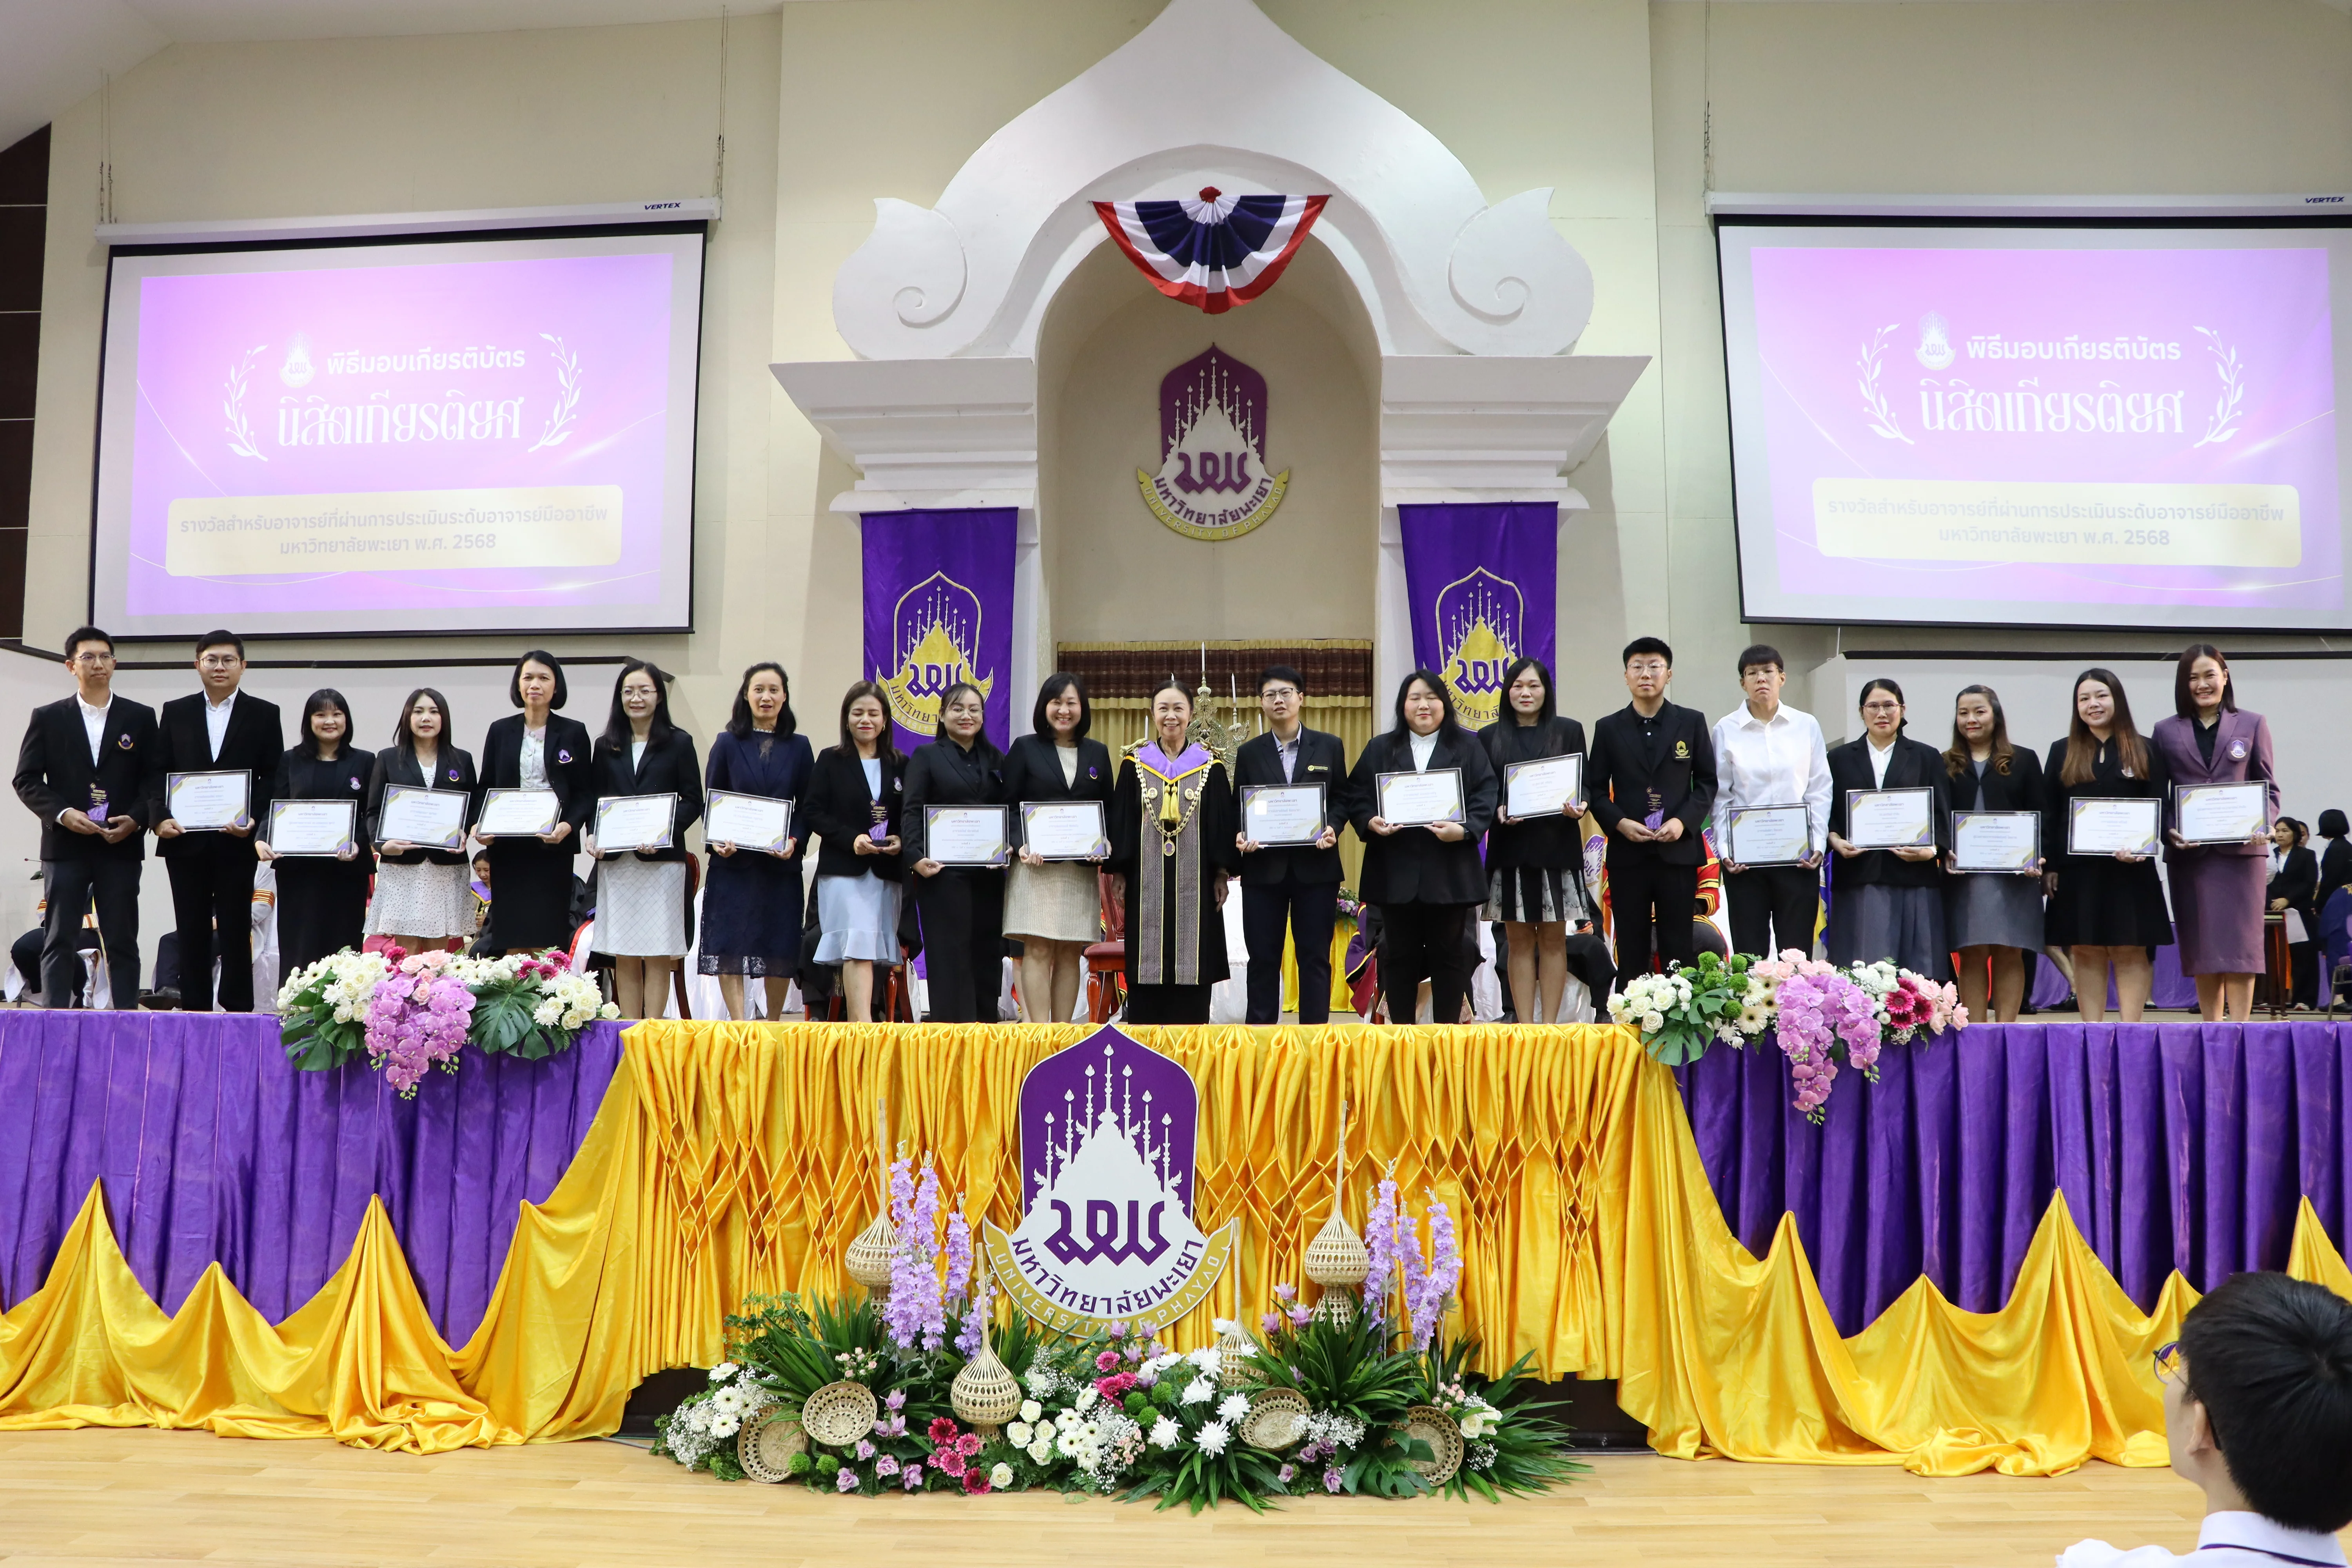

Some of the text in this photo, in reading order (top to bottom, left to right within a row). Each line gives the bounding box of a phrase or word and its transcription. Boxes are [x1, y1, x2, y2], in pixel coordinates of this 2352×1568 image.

[327, 345, 525, 375] พิธีมอบเกียรติบัตร
[1966, 334, 2182, 360] พิธีมอบเกียรติบัตร
[278, 389, 525, 446] นิสิตเกียรติยศ
[1919, 377, 2185, 433] นิสิตเกียรติยศ
[1143, 487, 1214, 538] UNIVERSITY
[1221, 527, 1239, 538] OF
[1153, 477, 1272, 525] มหาวิทยาลัยพะเยา
[1828, 496, 2284, 521] รางวัลสำหรับอาจารย์ที่ผ่านการประเมินระดับอาจารย์มืออาชีพ
[180, 504, 607, 533] รางวัลสำหรับอาจารย์ที่ผ่านการประเมินระดับอาจารย์มืออาชีพ
[280, 533, 496, 554] มหาวิทยาลัยพะเยา พ.ศ. 2568
[1939, 526, 2170, 545] มหาวิทยาลัยพะเยา พ.ศ. 2568
[1012, 1237, 1204, 1315] มหาวิทยาลัยพะเยา
